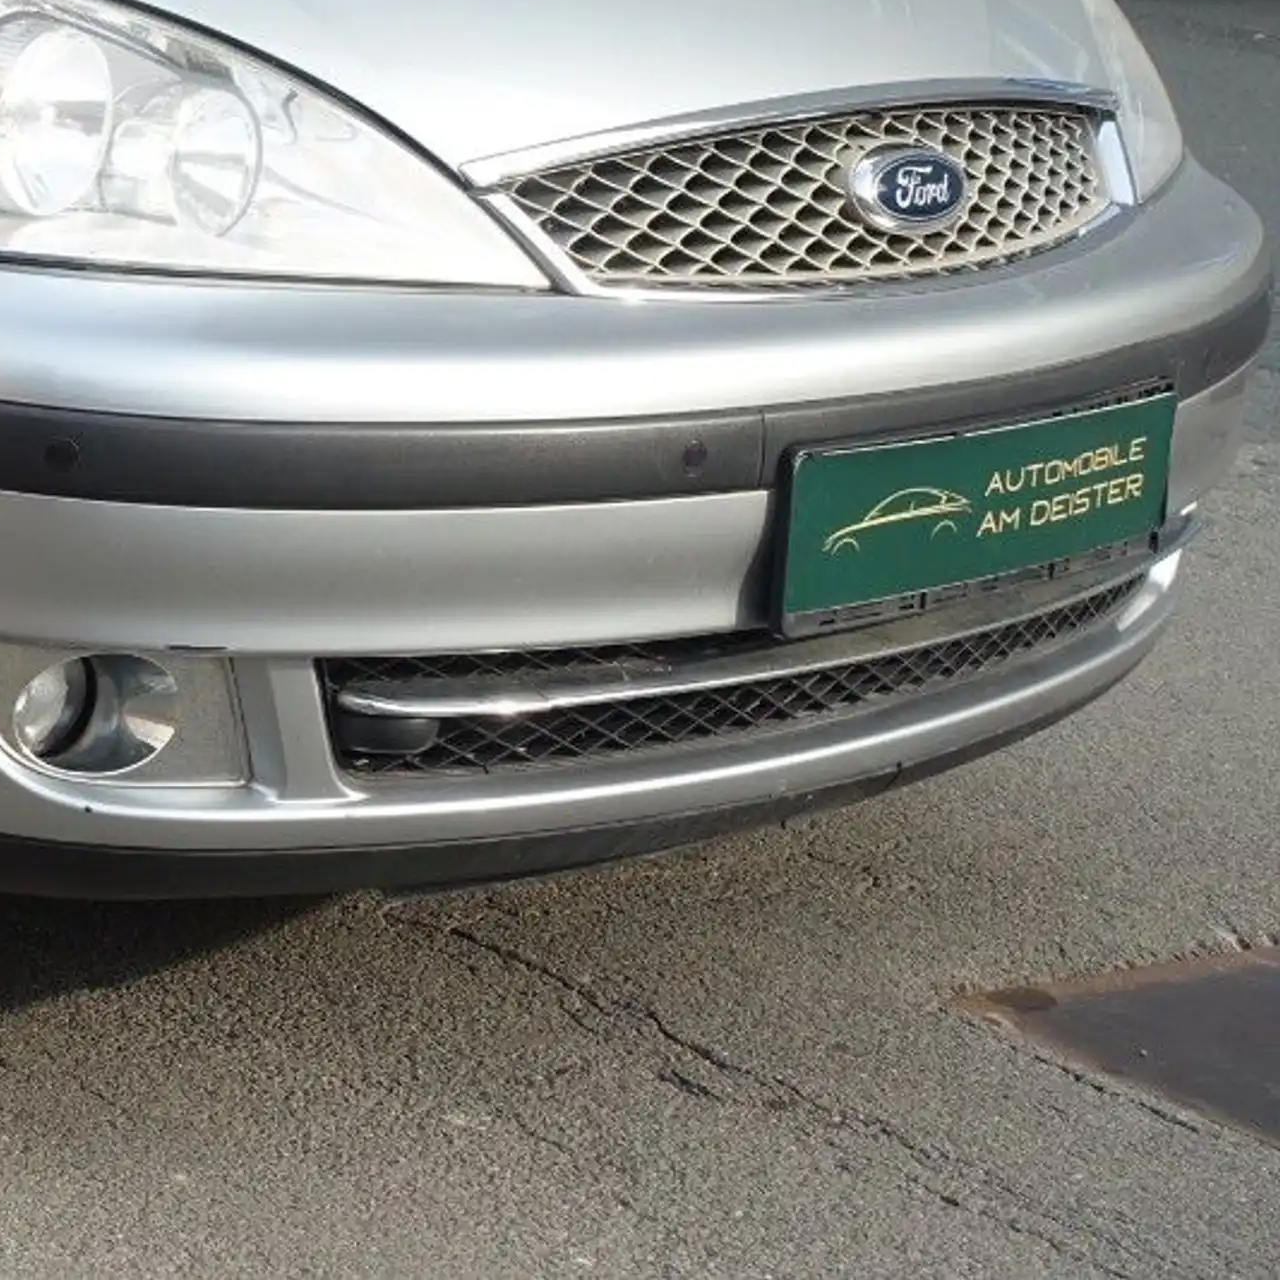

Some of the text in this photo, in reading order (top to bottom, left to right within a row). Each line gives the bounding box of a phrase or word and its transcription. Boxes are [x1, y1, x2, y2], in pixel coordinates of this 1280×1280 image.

[896, 166, 951, 209] Ford
[984, 437, 1148, 498] AUTOMOBILE
[976, 473, 1146, 538] AM DEISTER
